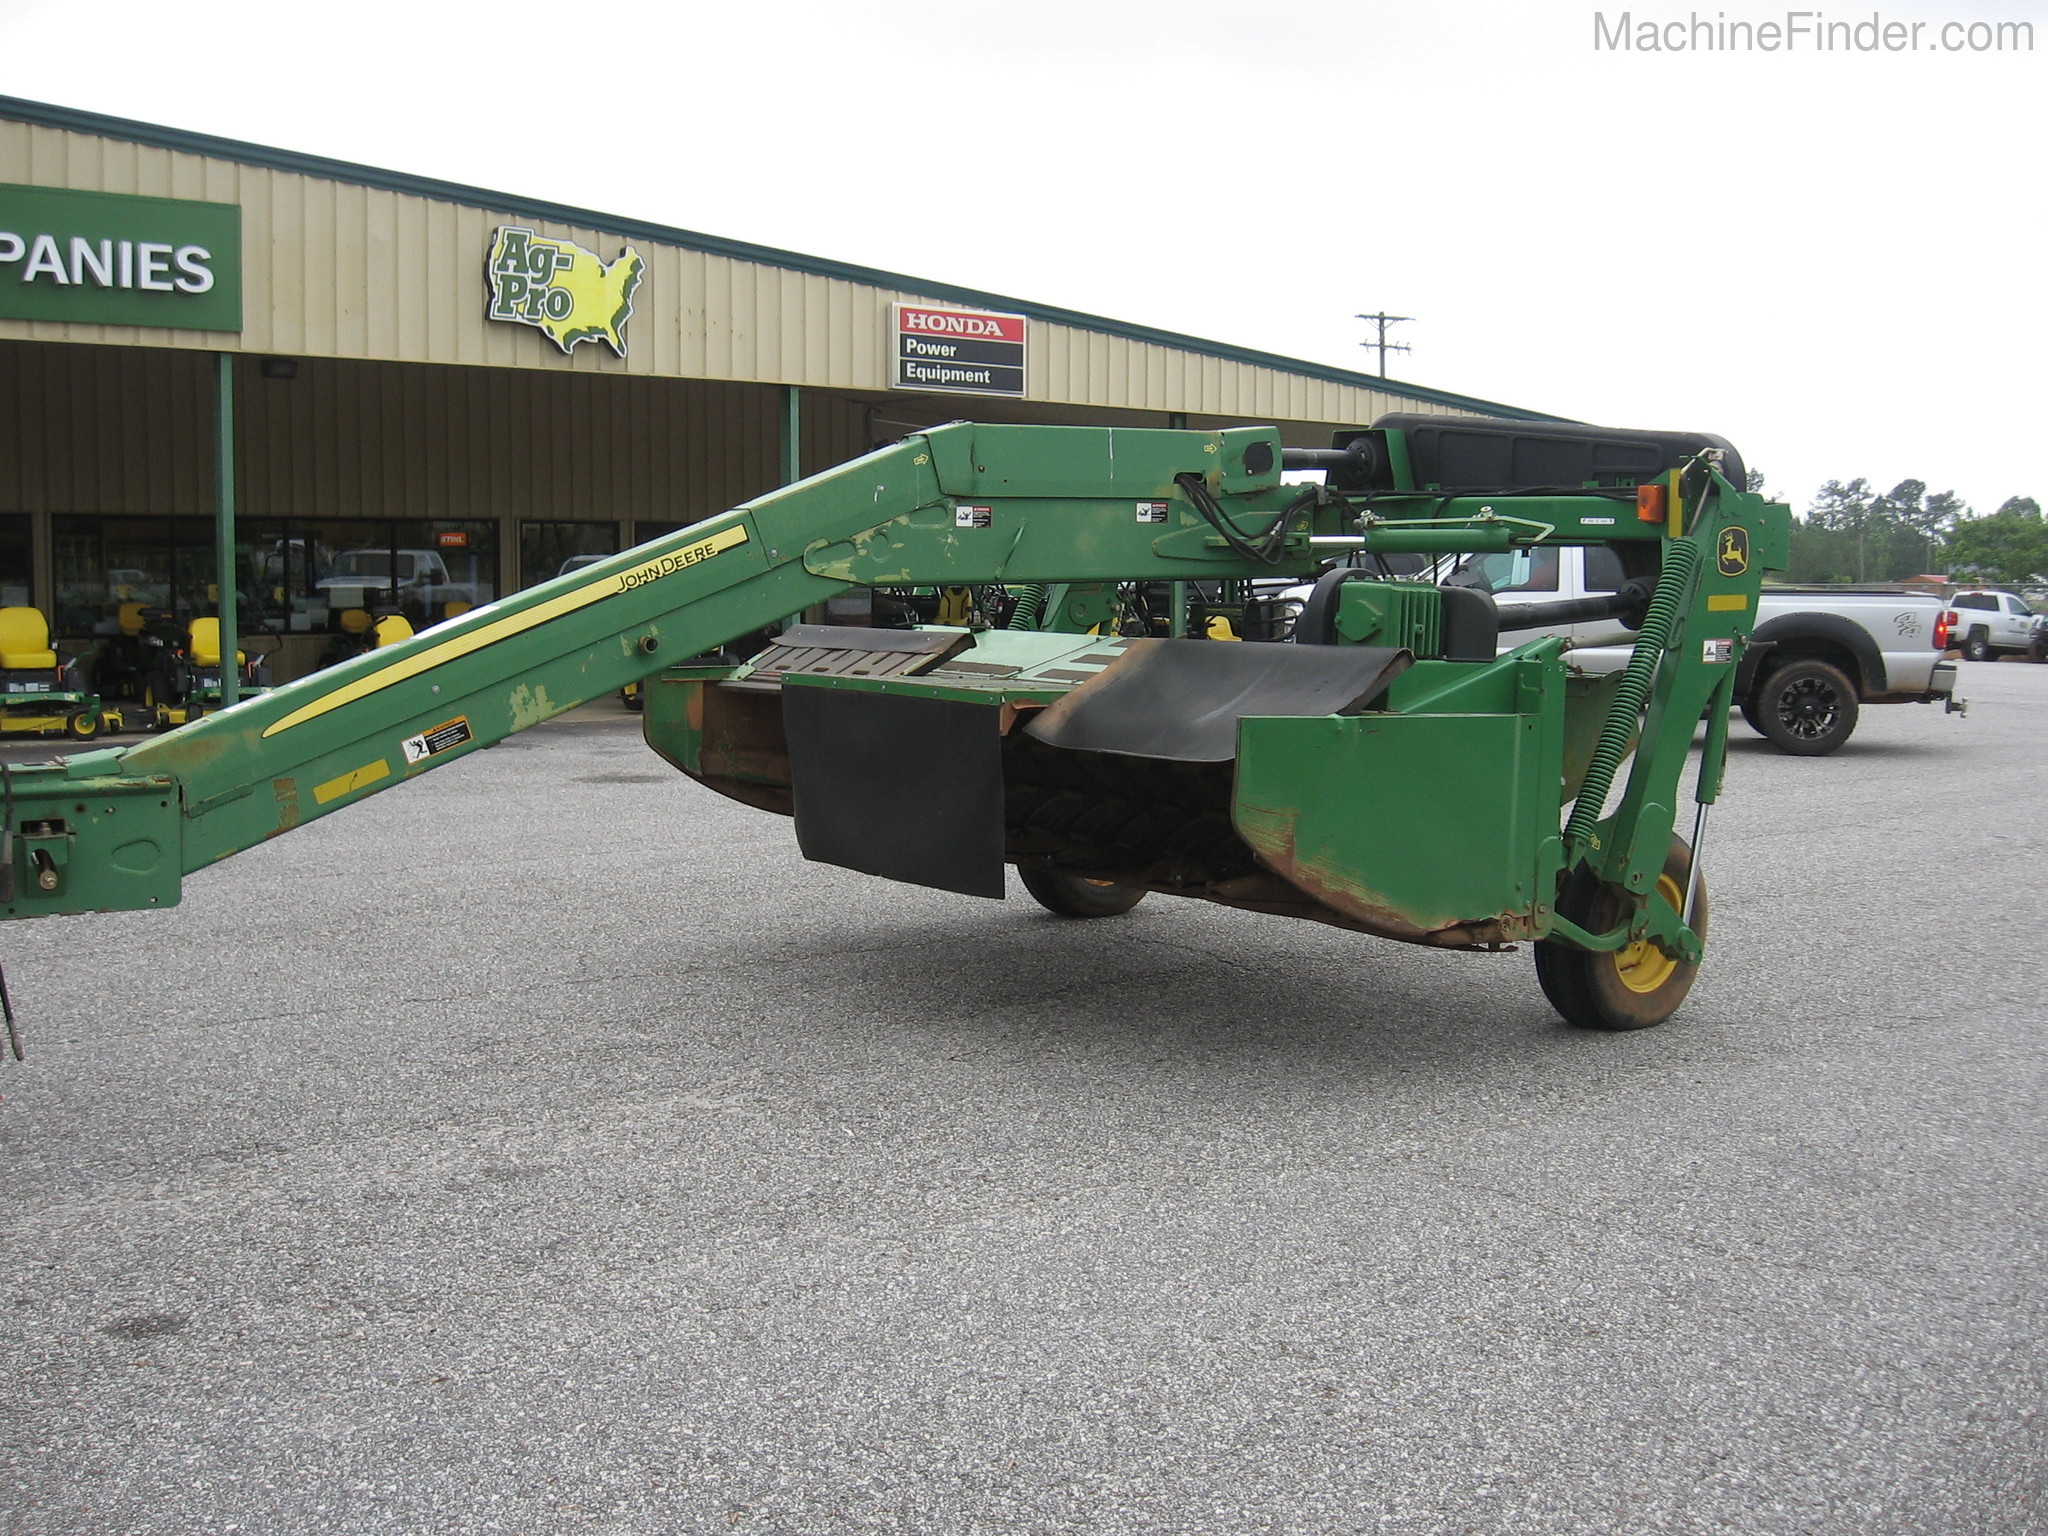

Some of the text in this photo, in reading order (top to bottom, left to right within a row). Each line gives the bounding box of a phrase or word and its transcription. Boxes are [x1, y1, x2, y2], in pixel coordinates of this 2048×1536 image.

[496, 232, 572, 285] Ag-
[496, 274, 572, 318] Pro
[906, 312, 1004, 337] HONDA
[906, 338, 957, 358] Power
[906, 363, 991, 384] Equipment
[617, 543, 716, 593] JOHN DEERE
